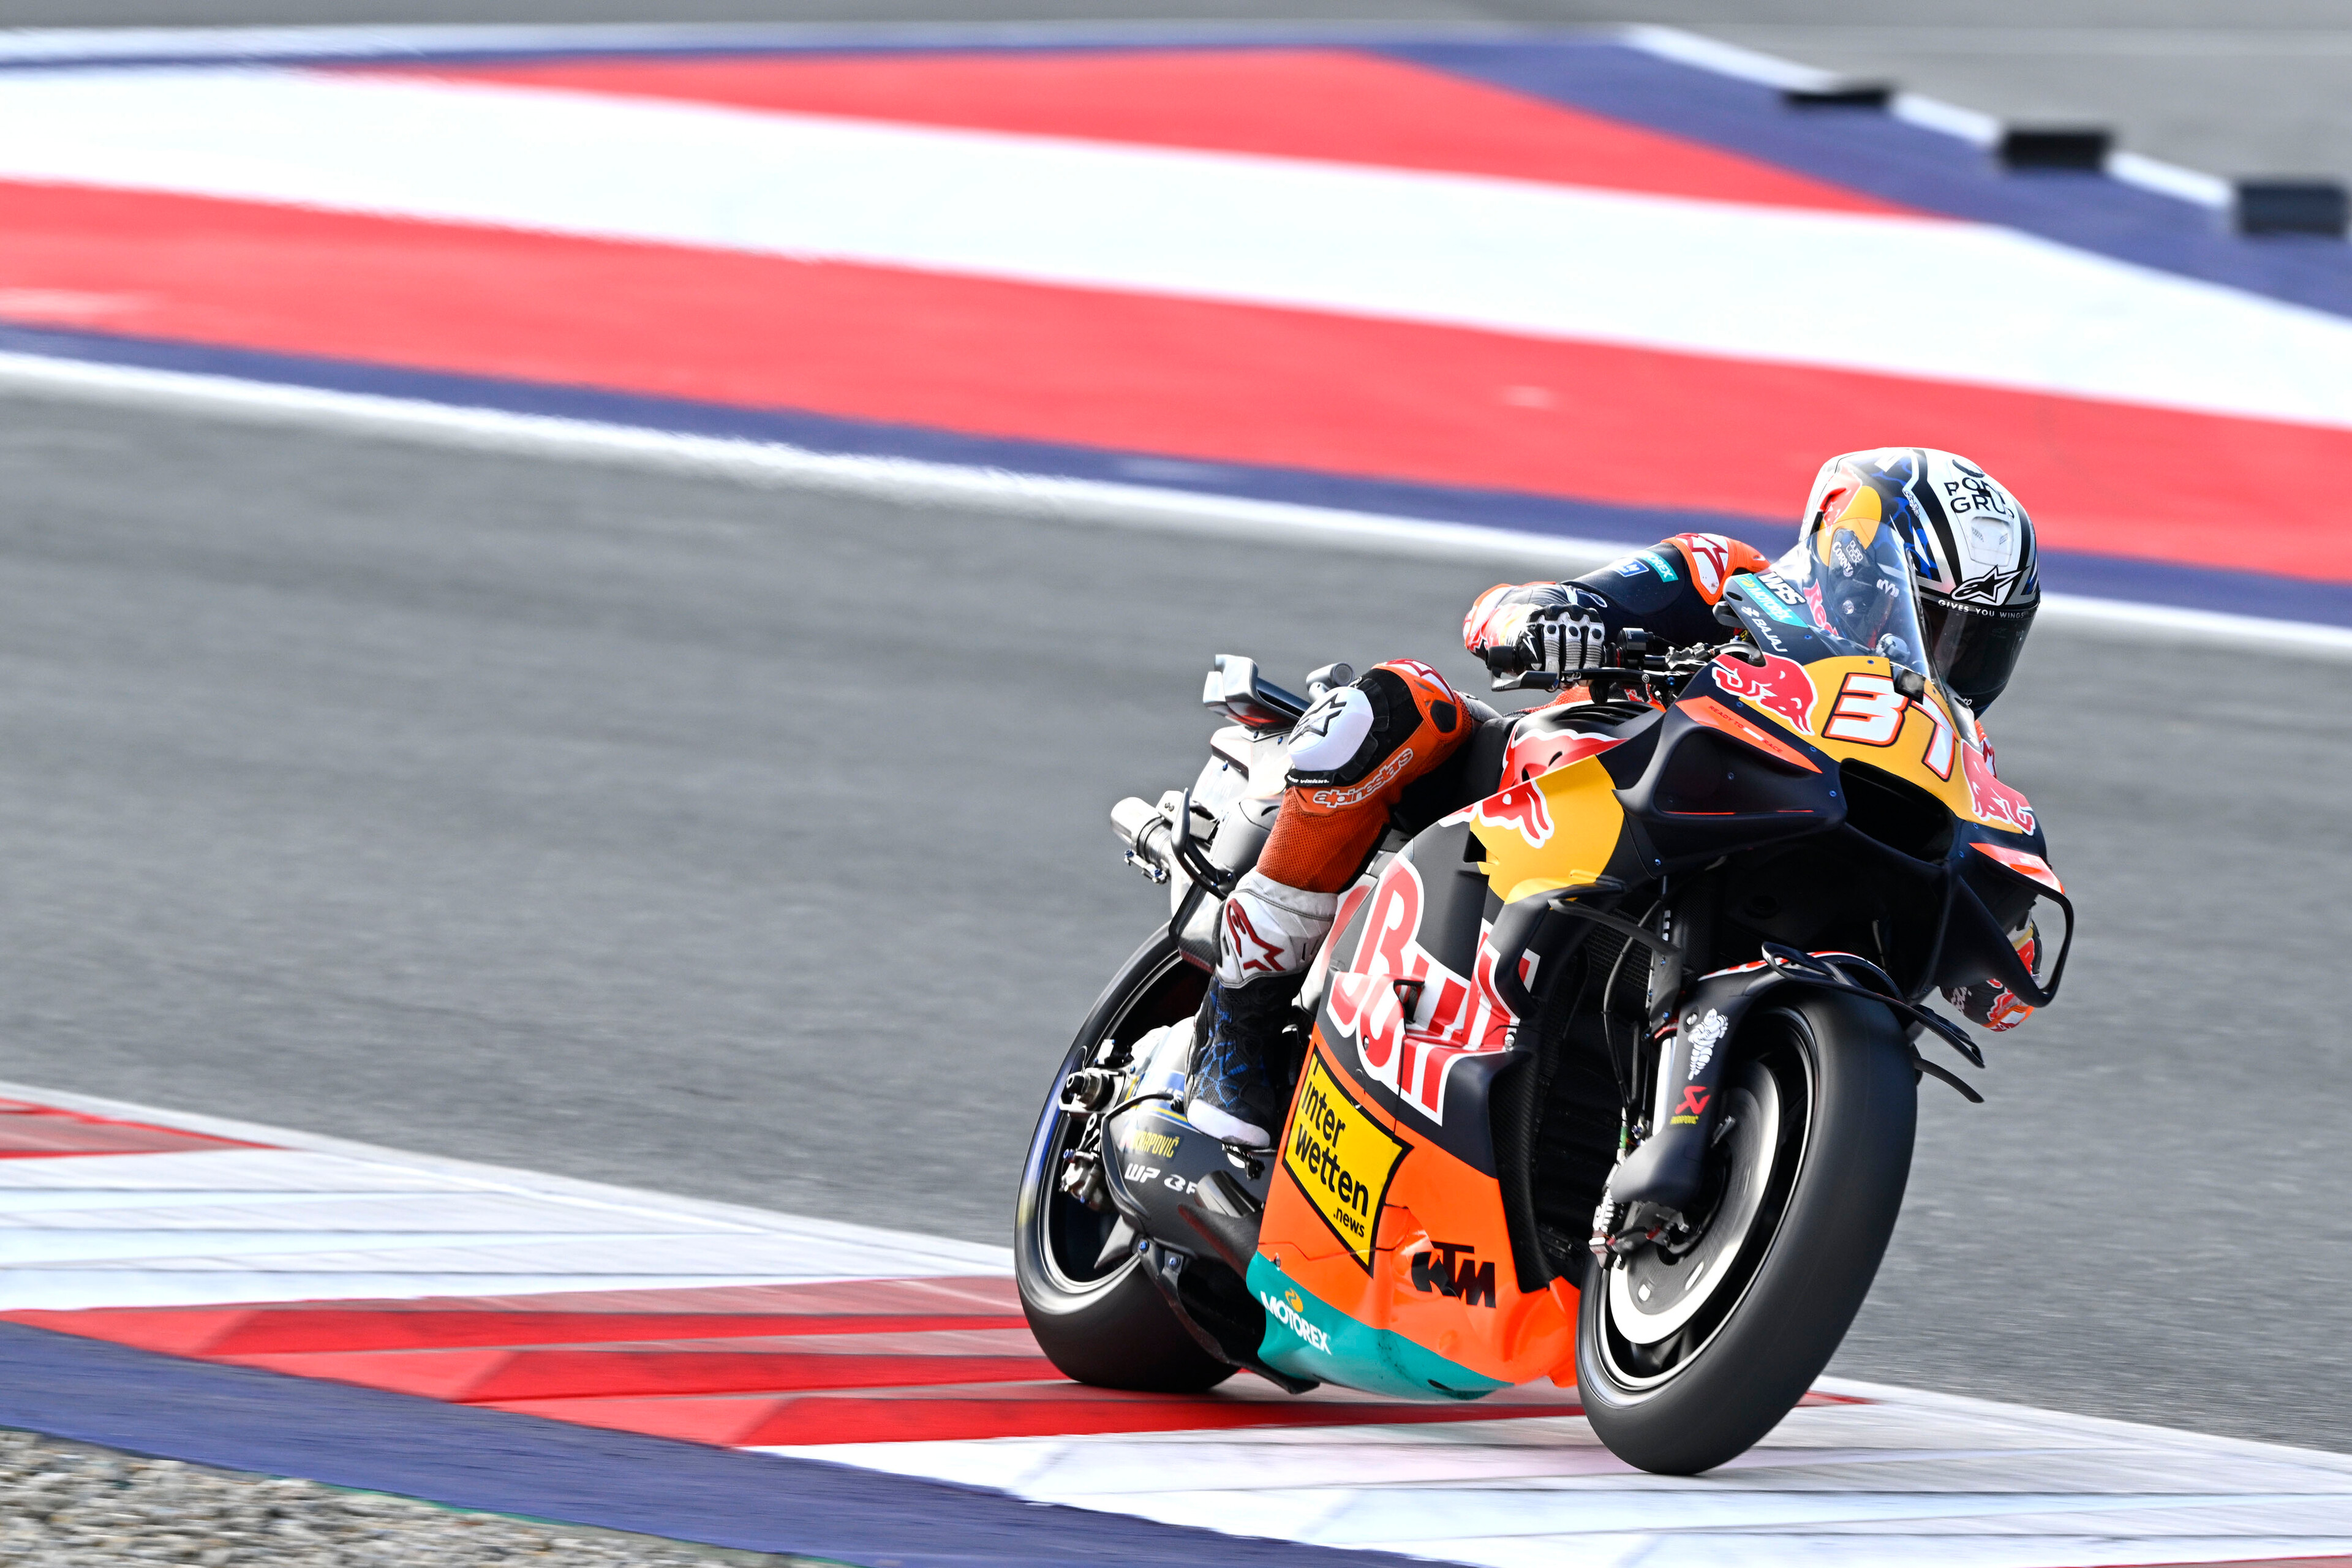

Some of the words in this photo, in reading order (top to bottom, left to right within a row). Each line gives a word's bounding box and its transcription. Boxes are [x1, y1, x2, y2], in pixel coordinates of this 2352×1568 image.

[1938, 600, 1969, 612] GIVES
[1975, 608, 1995, 617] YOU
[1752, 618, 1789, 652] BAJAJ
[1708, 706, 1733, 722] READY
[1763, 739, 1783, 753] RACE
[1125, 1163, 1161, 1183] WP
[1295, 1123, 1369, 1218] wetten
[1411, 1241, 1496, 1309] KTM
[1260, 1290, 1332, 1355] MOTOREX
